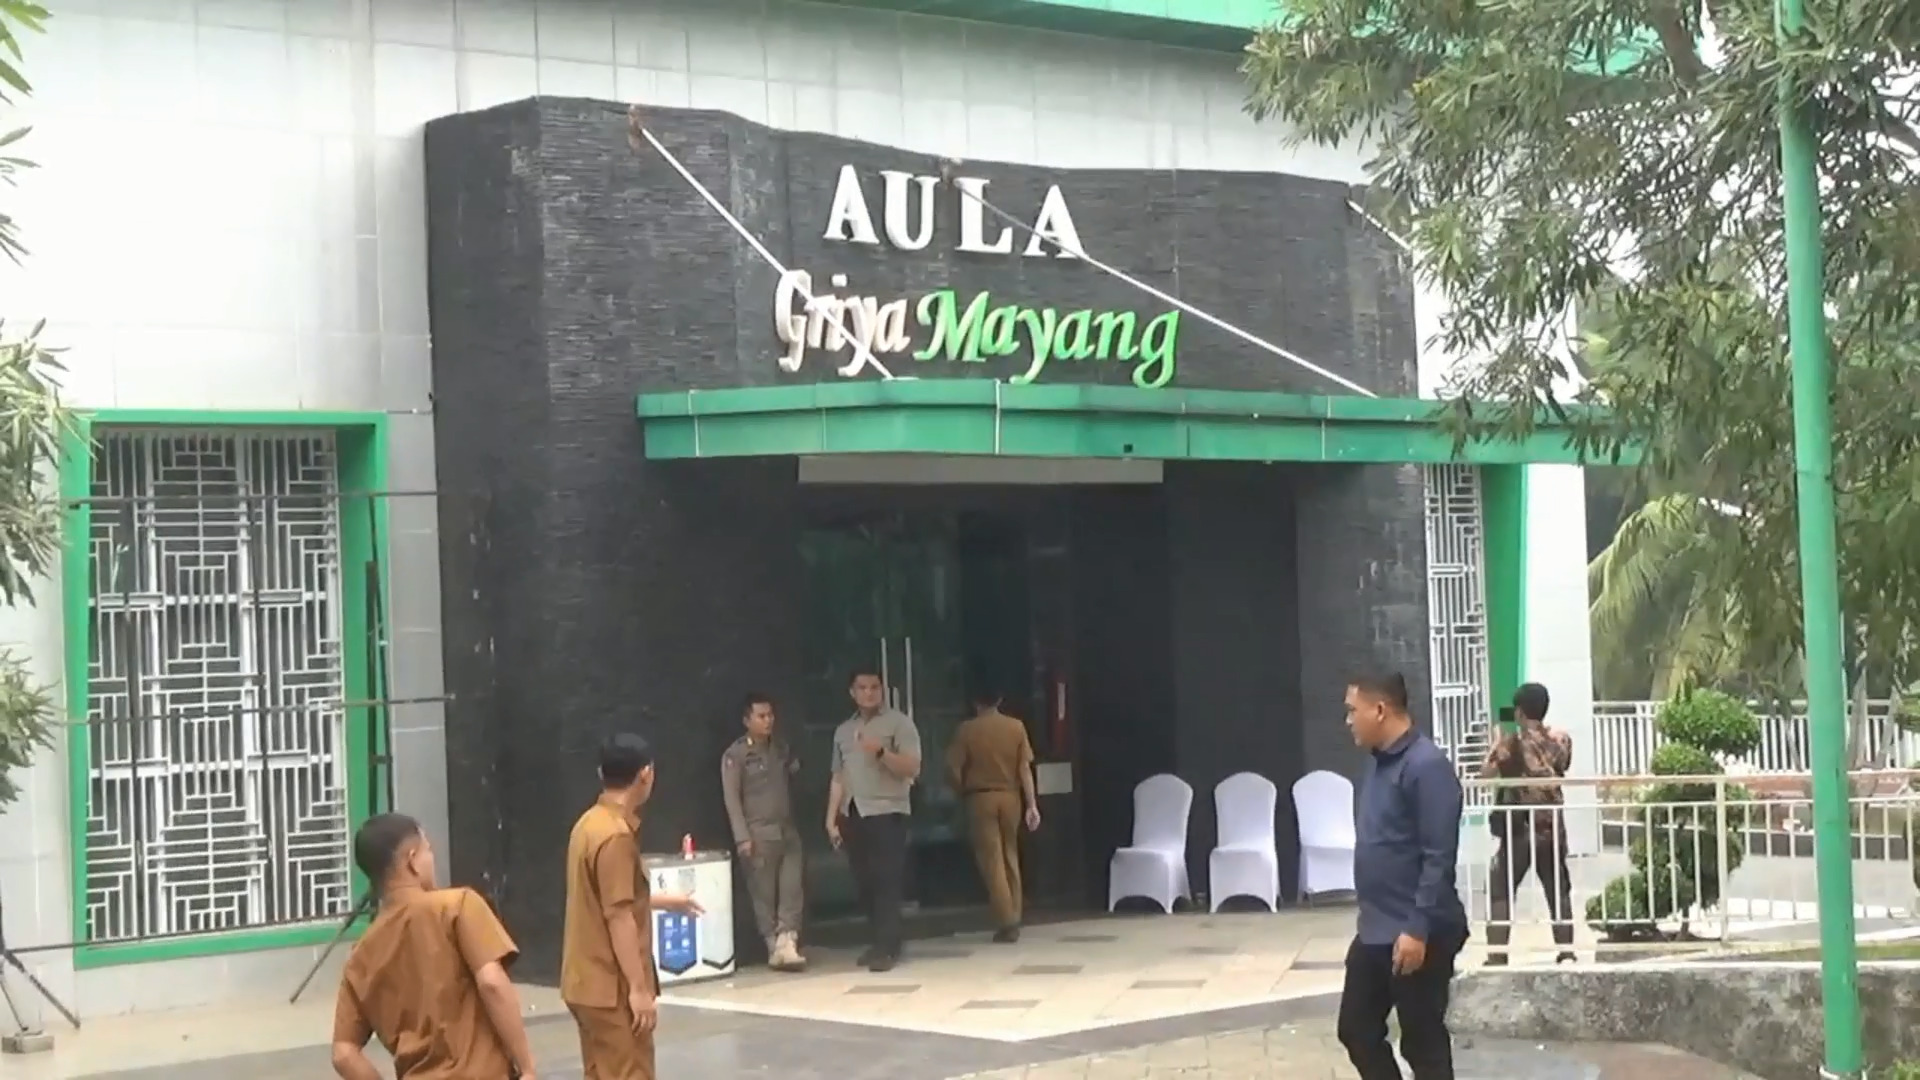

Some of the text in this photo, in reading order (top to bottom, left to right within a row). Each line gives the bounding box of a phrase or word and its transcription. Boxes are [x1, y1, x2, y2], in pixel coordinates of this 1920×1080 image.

[822, 164, 1087, 259] AULA
[774, 270, 1179, 389] Griya Mayang
